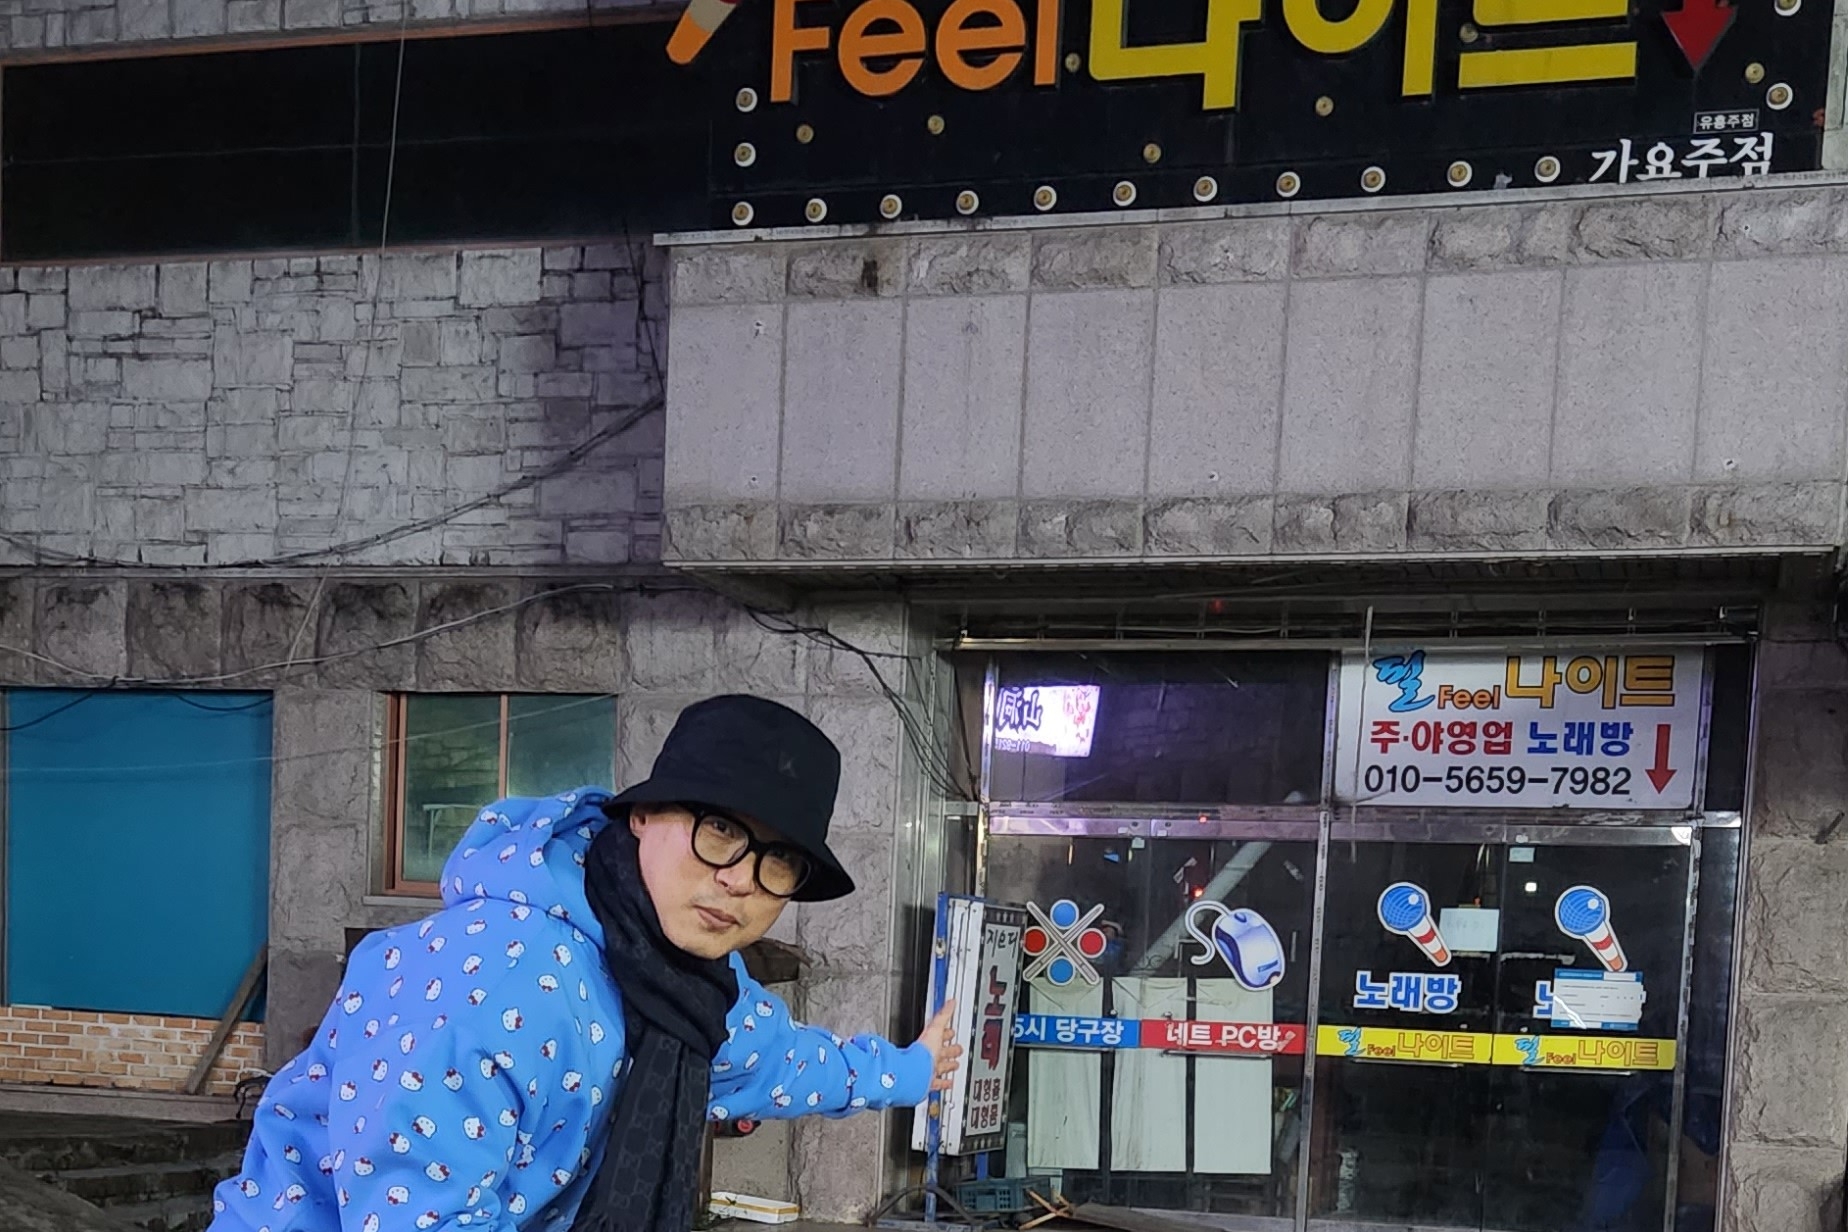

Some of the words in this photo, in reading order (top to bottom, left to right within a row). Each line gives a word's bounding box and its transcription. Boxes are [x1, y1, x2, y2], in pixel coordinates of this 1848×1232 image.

[771, 0, 1058, 102] Feel
[1699, 113, 1754, 130] 유흥주점
[1588, 132, 1774, 183] 가요주점
[1437, 685, 1500, 710] Feel
[1505, 655, 1676, 709] 나이트
[1370, 720, 1513, 756] 주·야영업
[1527, 721, 1634, 757] 노래방
[1364, 764, 1632, 796] 010-5659-7982
[1353, 970, 1462, 1014] 노래방
[1056, 1019, 1124, 1045] 당구장
[1220, 1025, 1281, 1051] PC방
[1366, 1043, 1396, 1057] Feel
[1397, 1032, 1475, 1060] 나이트
[1546, 1051, 1576, 1066] Feel
[1578, 1039, 1659, 1067] 나이트
